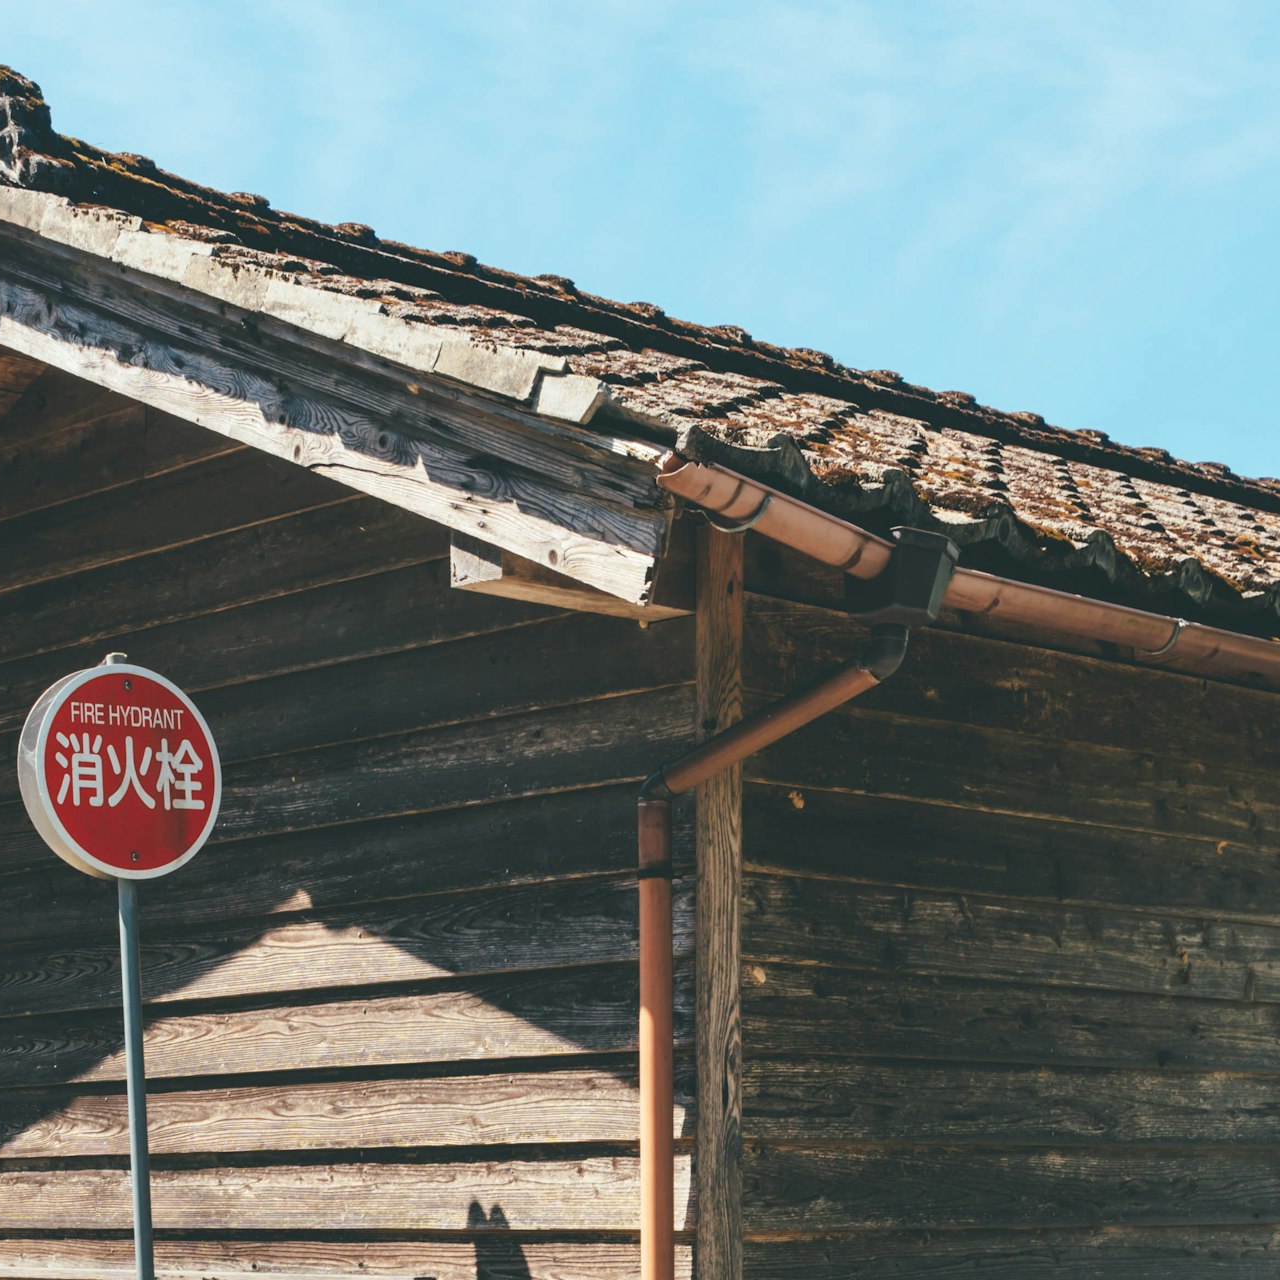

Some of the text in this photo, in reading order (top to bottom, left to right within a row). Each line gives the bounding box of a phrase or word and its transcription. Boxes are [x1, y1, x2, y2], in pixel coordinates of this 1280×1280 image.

[70, 701, 184, 730] FIRE HYDRANT
[55, 731, 206, 811] 消火栓
